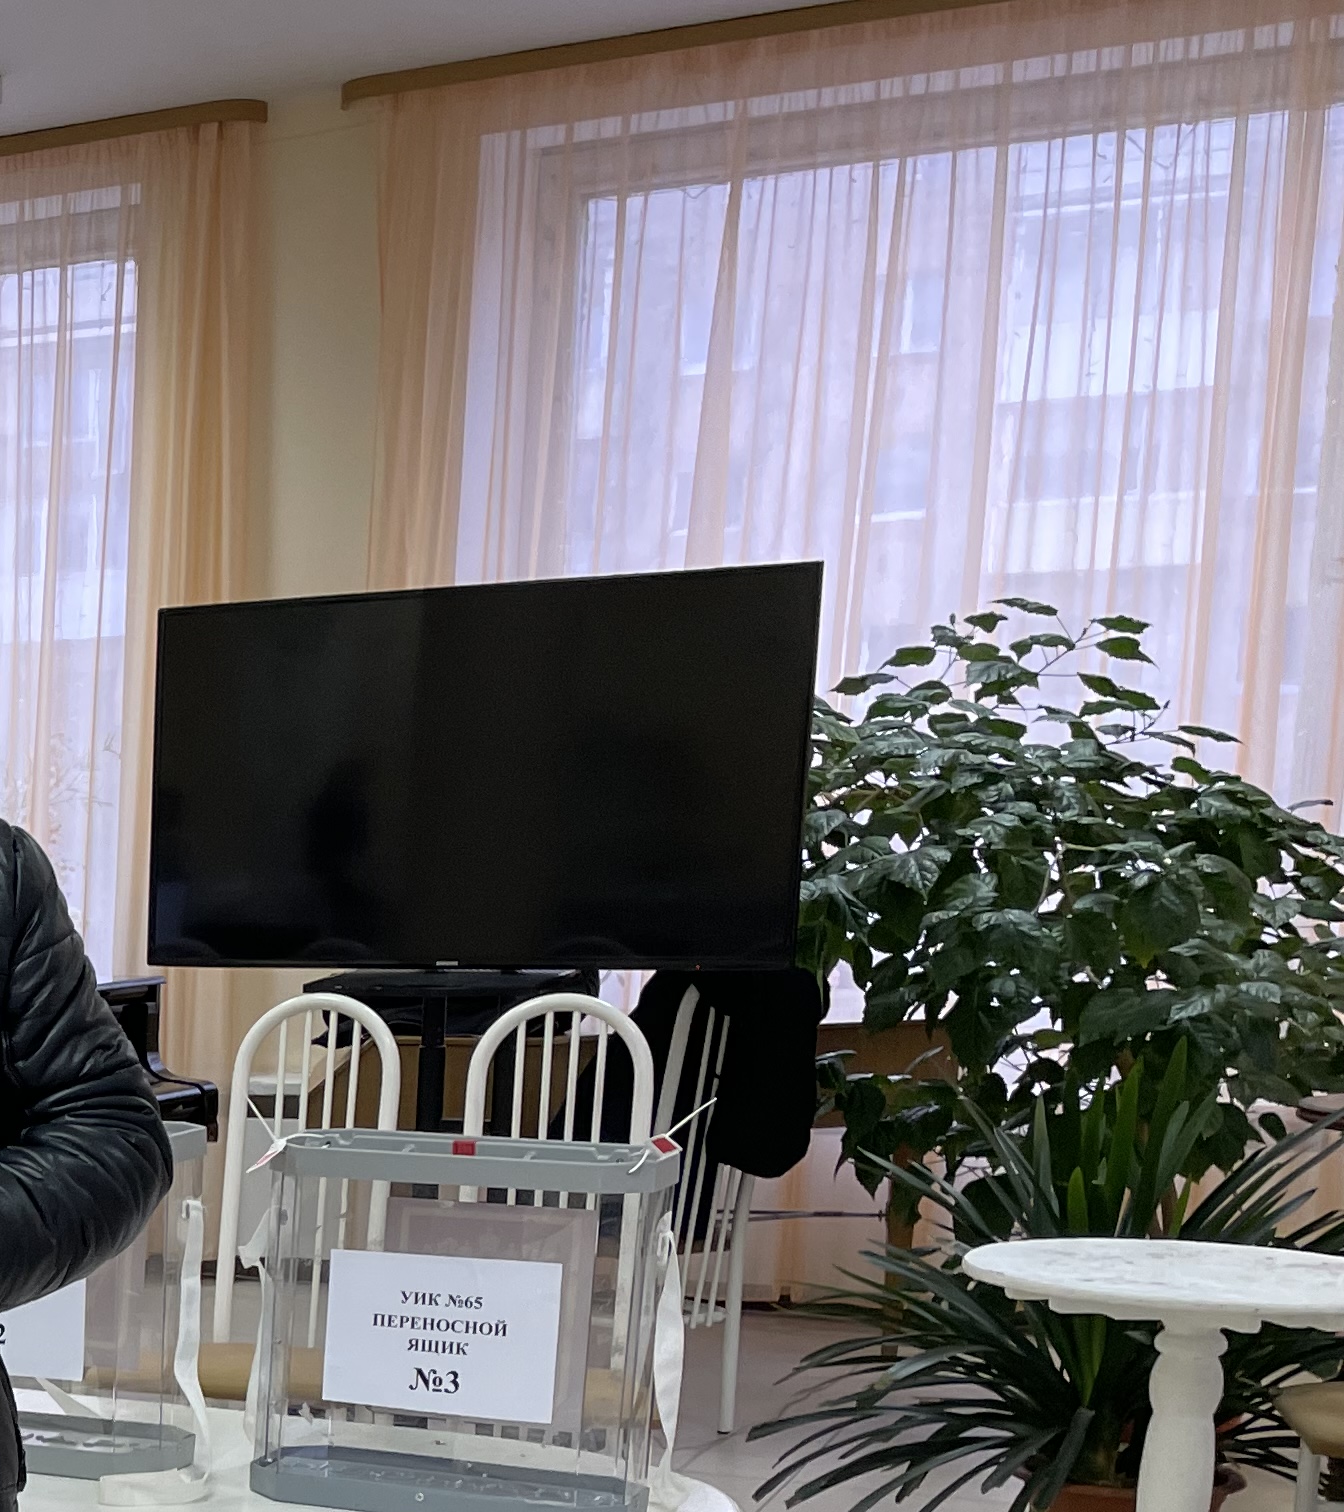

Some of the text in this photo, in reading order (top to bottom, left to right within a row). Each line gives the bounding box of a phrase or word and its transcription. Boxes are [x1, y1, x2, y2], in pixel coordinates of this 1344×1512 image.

[400, 1290, 484, 1310] УИК №65
[372, 1313, 508, 1338] ПЕРЕНОСНОЙ
[407, 1338, 469, 1356] ЯЩИК
[408, 1366, 460, 1394] №3
